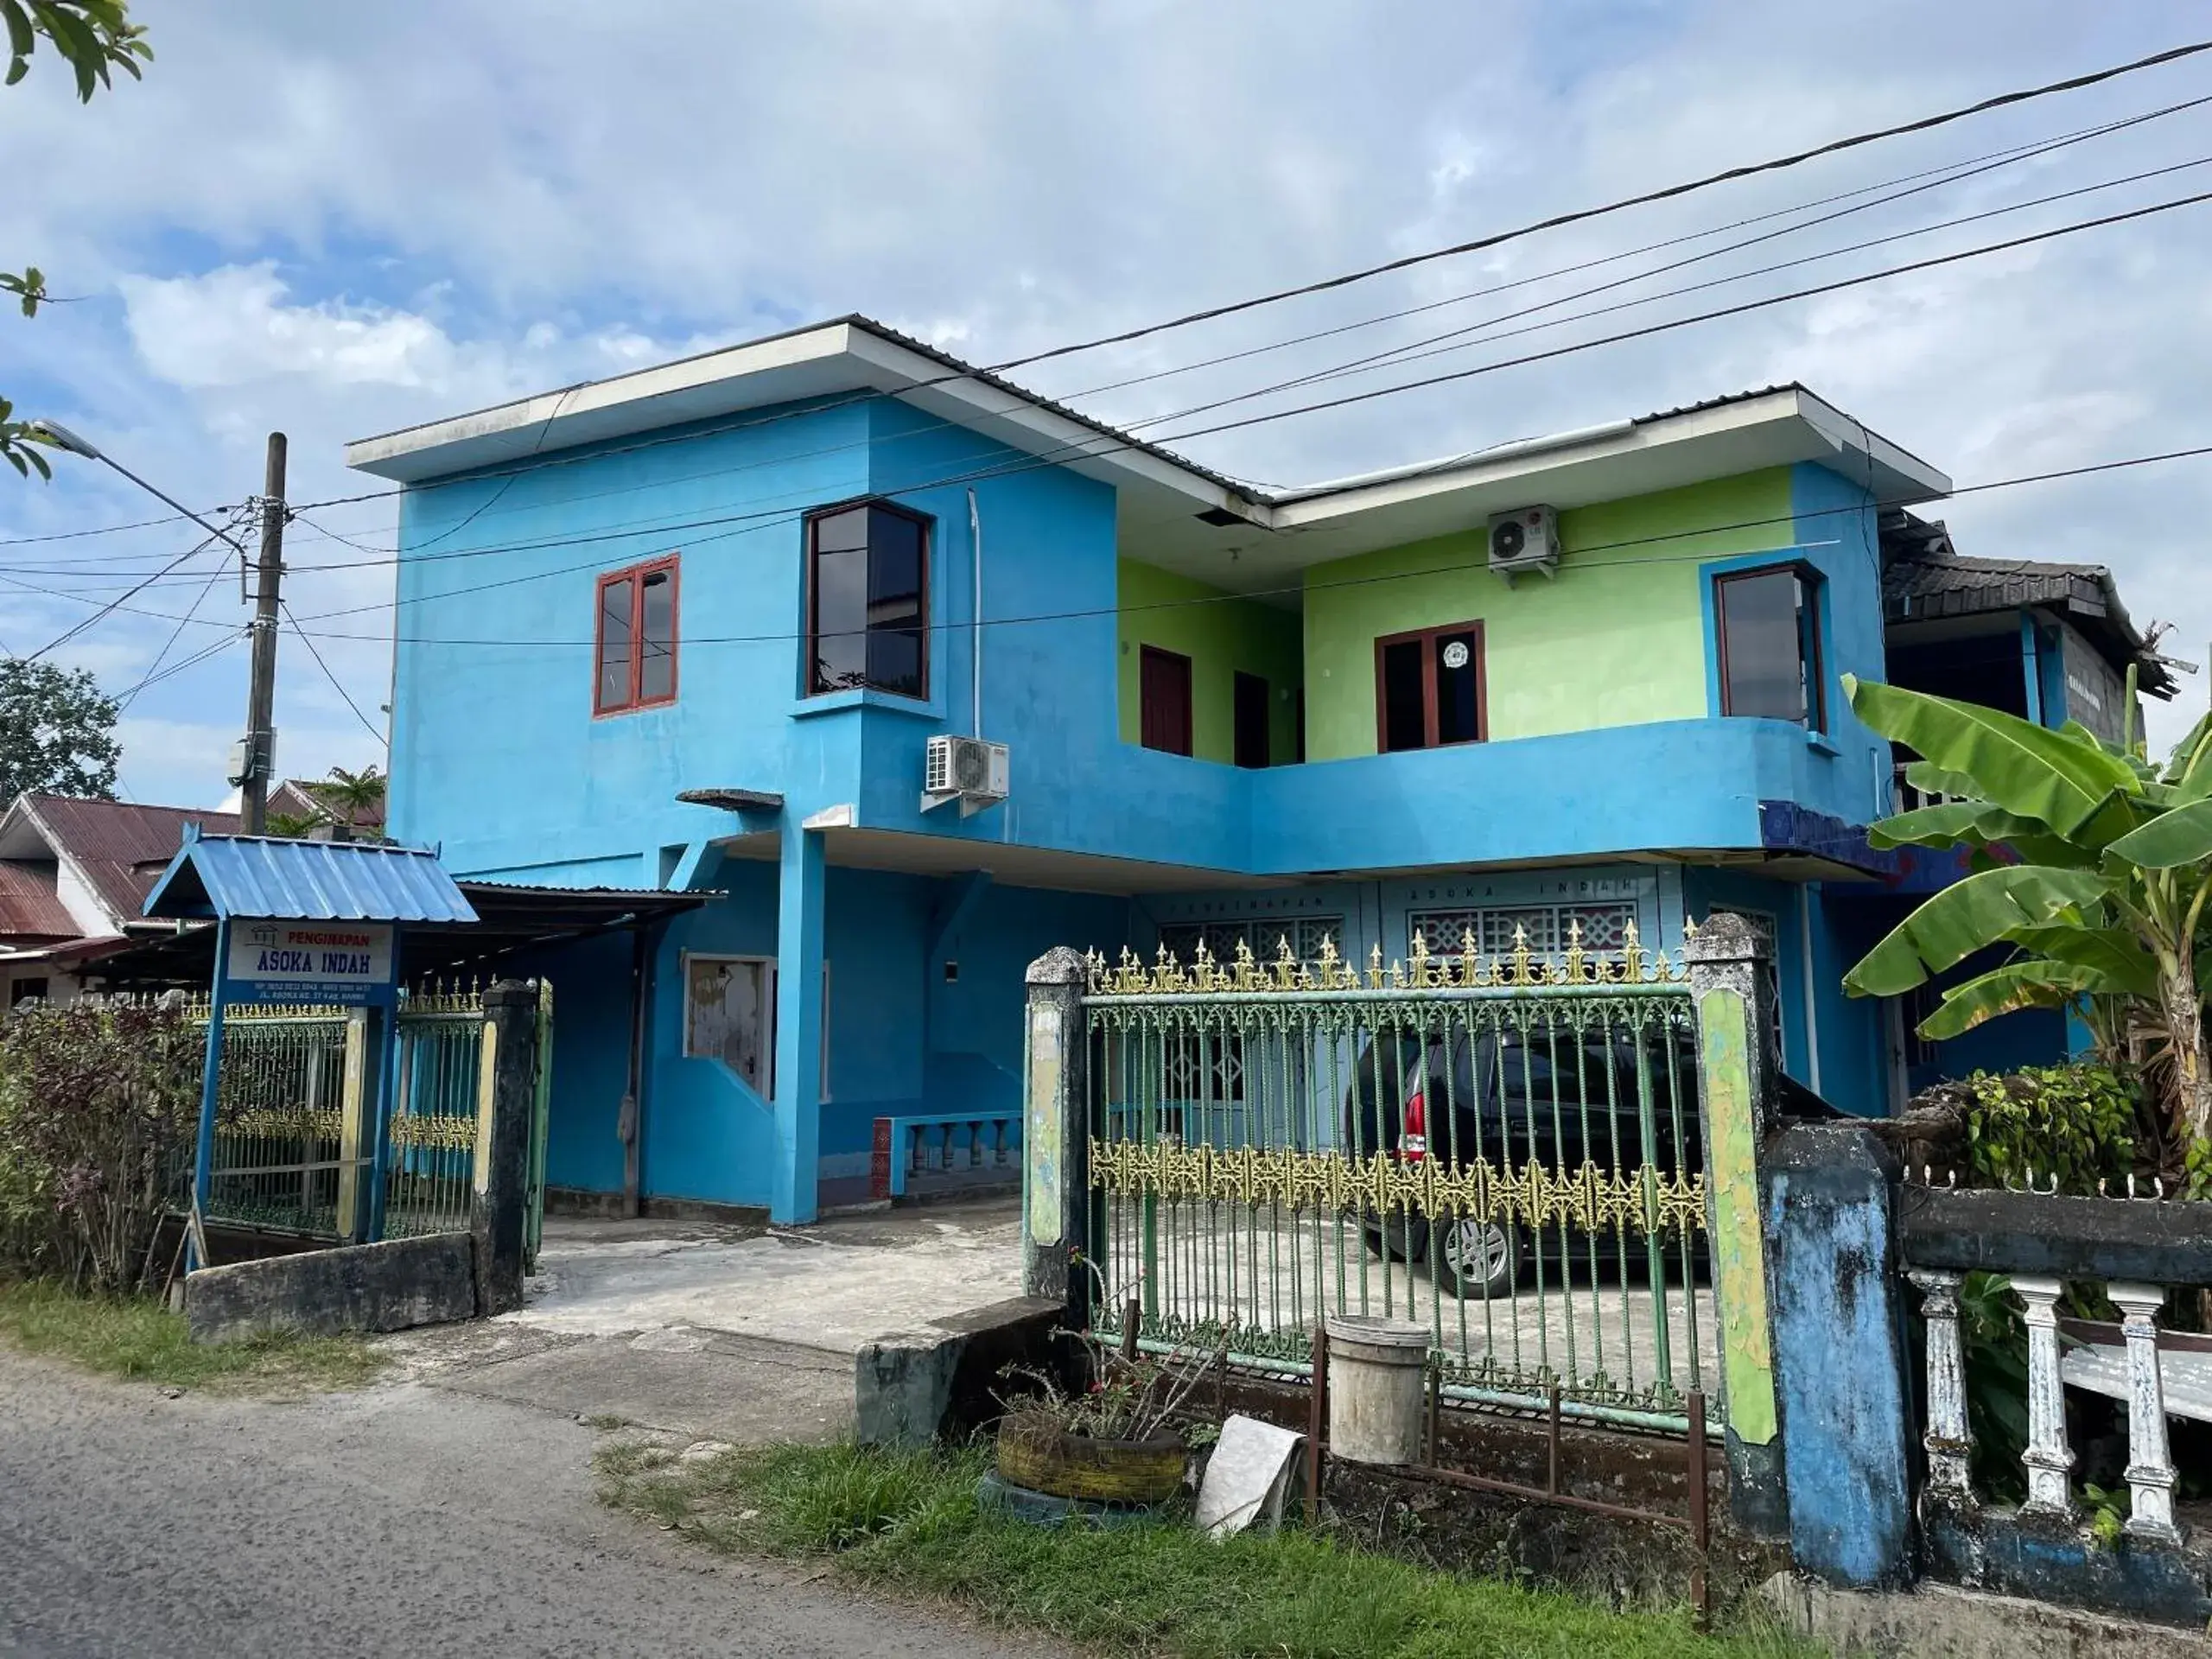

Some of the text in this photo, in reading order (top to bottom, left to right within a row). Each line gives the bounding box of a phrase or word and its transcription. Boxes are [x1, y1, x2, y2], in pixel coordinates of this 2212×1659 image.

[1410, 877, 1631, 900] ASOKA INDAH
[288, 931, 370, 947] PENGINAPAN
[258, 951, 371, 975] ASOKA INDAH
